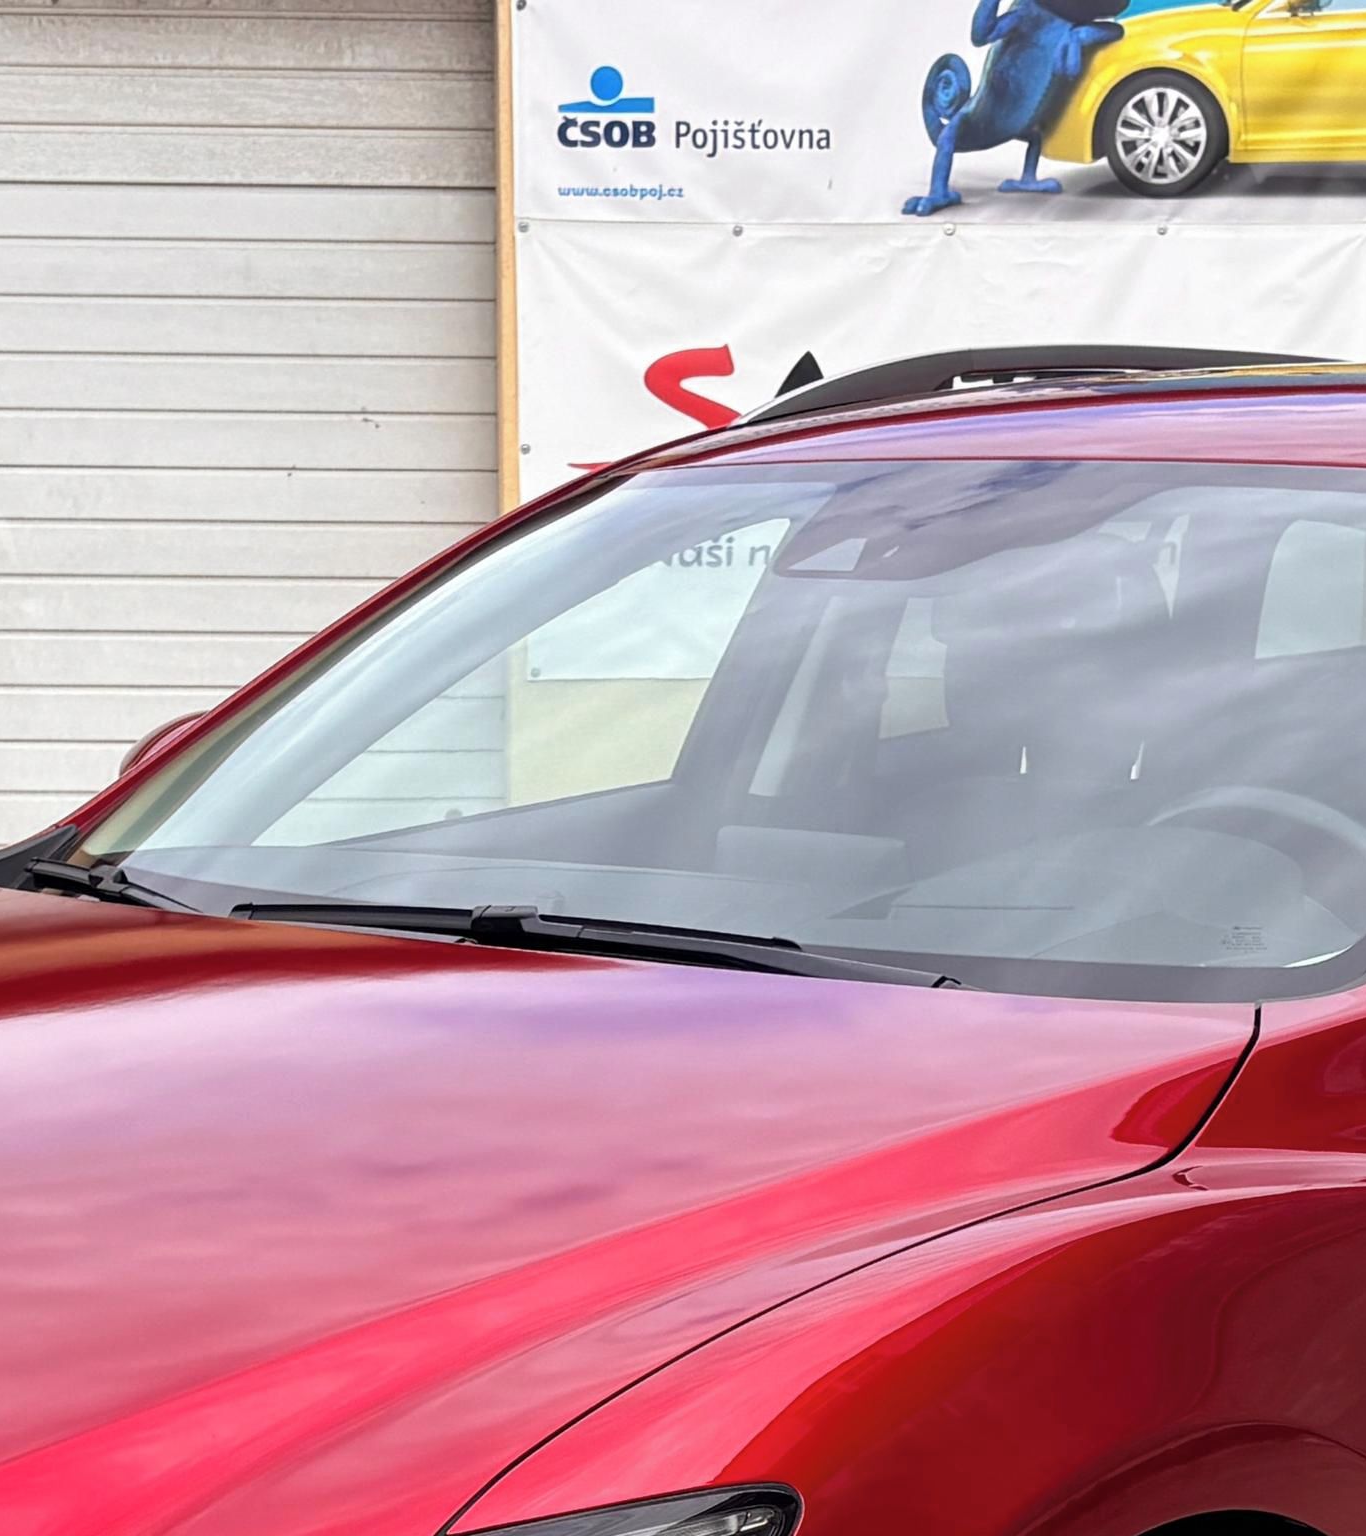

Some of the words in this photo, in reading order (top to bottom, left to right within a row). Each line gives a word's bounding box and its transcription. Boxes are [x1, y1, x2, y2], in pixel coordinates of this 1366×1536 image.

[557, 116, 656, 148] ČSOB
[675, 119, 832, 158] Pojišťovna
[557, 184, 685, 201] www.csobpoj.cz
